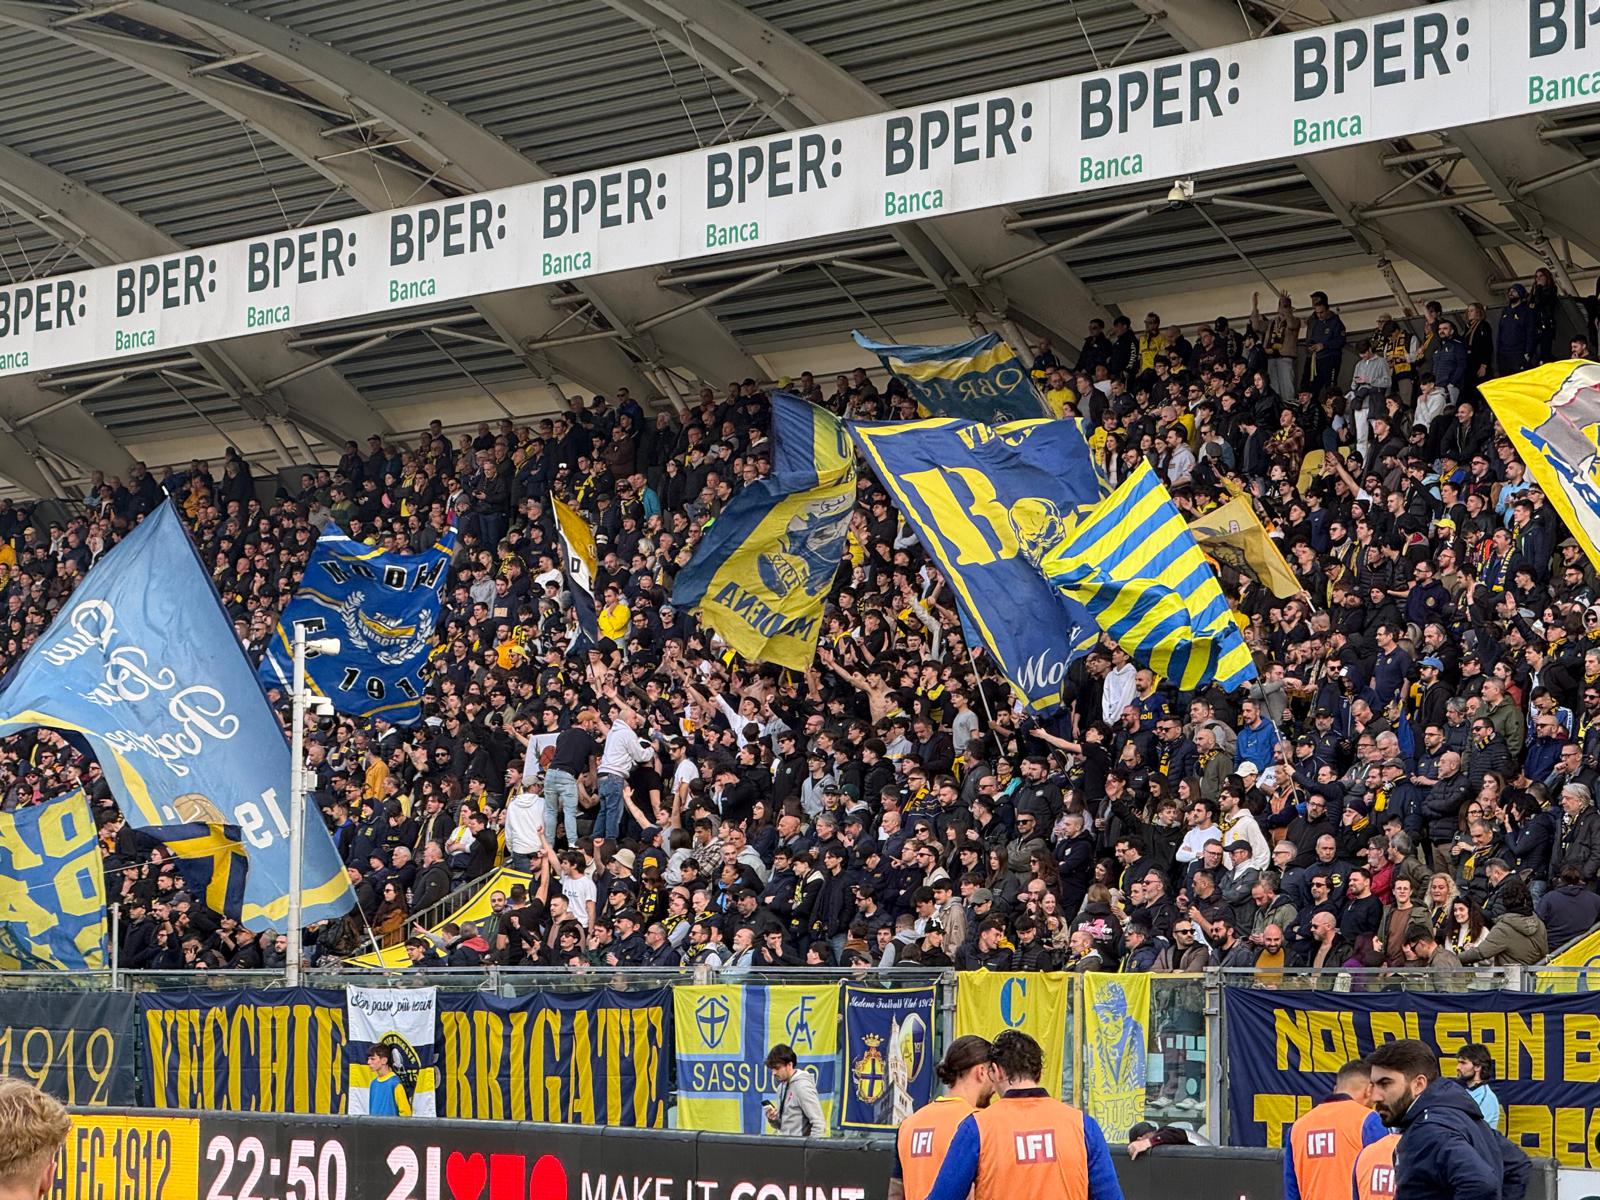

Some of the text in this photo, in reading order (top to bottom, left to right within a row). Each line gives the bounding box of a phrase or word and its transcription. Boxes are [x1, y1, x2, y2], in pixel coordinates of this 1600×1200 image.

[1529, 0, 1600, 58] BP
[1529, 72, 1600, 105] Banca
[1293, 114, 1362, 146] Banca
[1079, 150, 1143, 183] Banca
[884, 184, 944, 217] Banca
[706, 221, 759, 247] Banca
[542, 251, 591, 276] Banca
[389, 276, 436, 303] Banca
[247, 305, 290, 327] Banca
[115, 329, 155, 350] Banca
[0, 351, 29, 370] anca
[849, 996, 875, 1008] Modena
[876, 997, 902, 1009] Football
[146, 1004, 347, 1115] VECCHIE
[1434, 1012, 1546, 1081] SAN
[692, 1062, 819, 1093] SASSU
[911, 1131, 933, 1155] IFI
[1016, 1133, 1054, 1160] IFI
[1307, 1132, 1334, 1156] IFI
[76, 1126, 104, 1200] FC
[112, 1127, 172, 1200] 1912
[206, 1135, 347, 1200] 22:50
[581, 1172, 865, 1200] MAKE IT COUNT
